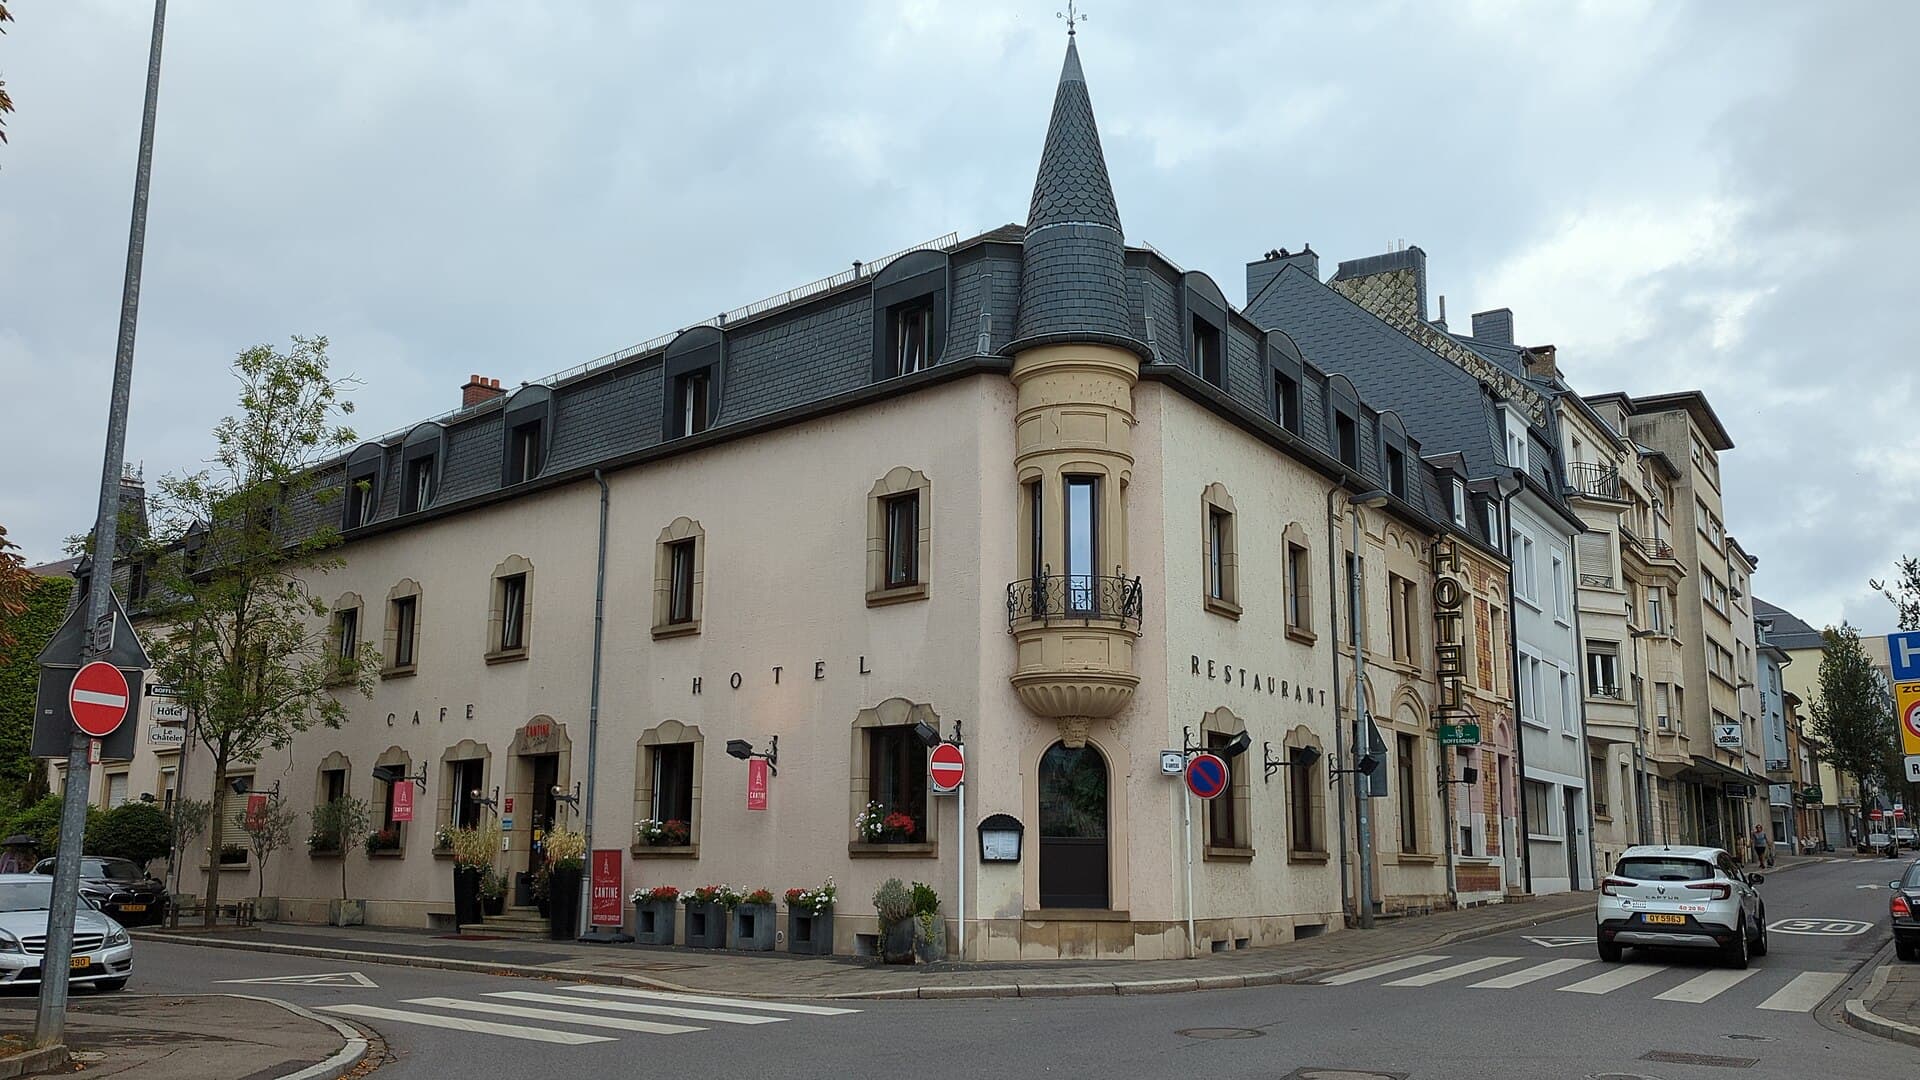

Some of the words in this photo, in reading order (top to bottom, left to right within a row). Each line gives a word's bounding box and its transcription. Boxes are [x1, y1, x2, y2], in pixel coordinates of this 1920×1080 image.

[692, 656, 871, 695] HOTEL
[1191, 654, 1326, 707] RESTAURANT
[386, 703, 474, 727] CAFE
[151, 733, 183, 741] Châtelet
[594, 887, 618, 898] CANTINE
